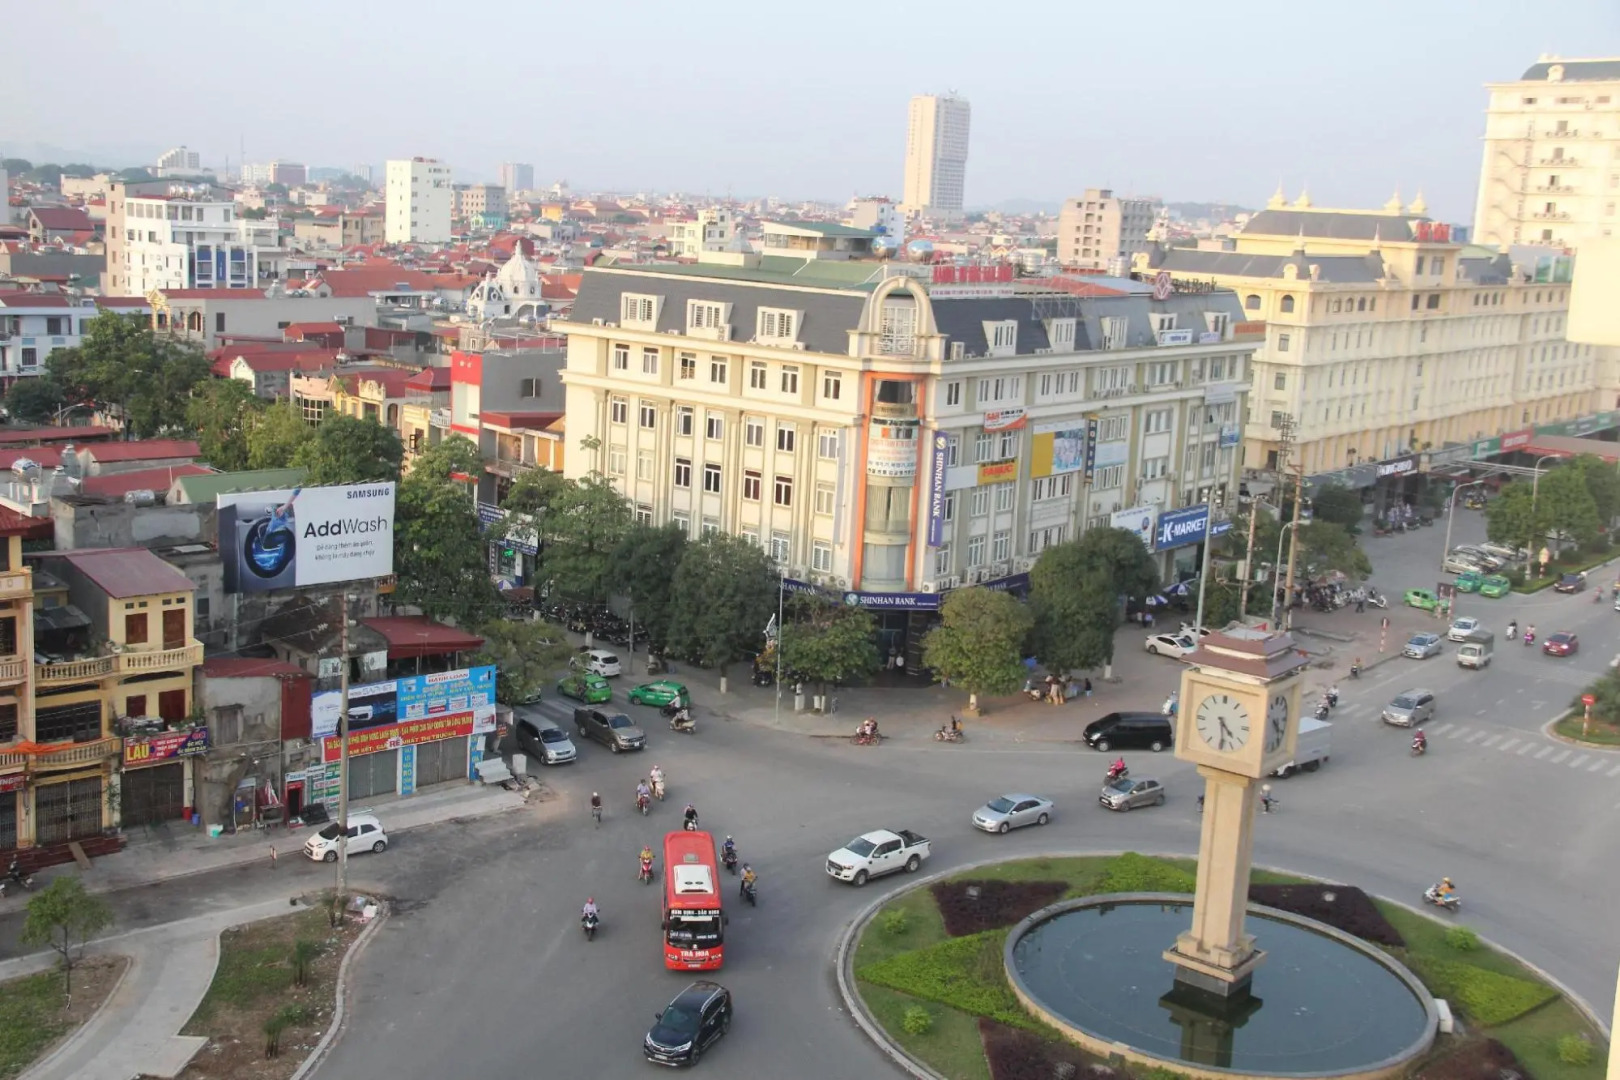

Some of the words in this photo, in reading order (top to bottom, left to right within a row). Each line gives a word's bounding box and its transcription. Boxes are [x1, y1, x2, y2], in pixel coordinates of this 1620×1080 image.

[934, 452, 944, 492] SHINHAN
[347, 488, 390, 499] SAMSUNG
[932, 493, 942, 517] BANK
[303, 515, 388, 539] AddWash
[1163, 517, 1207, 543] K-MARKET
[859, 596, 894, 606] SHINHAN
[895, 597, 916, 606] BANK
